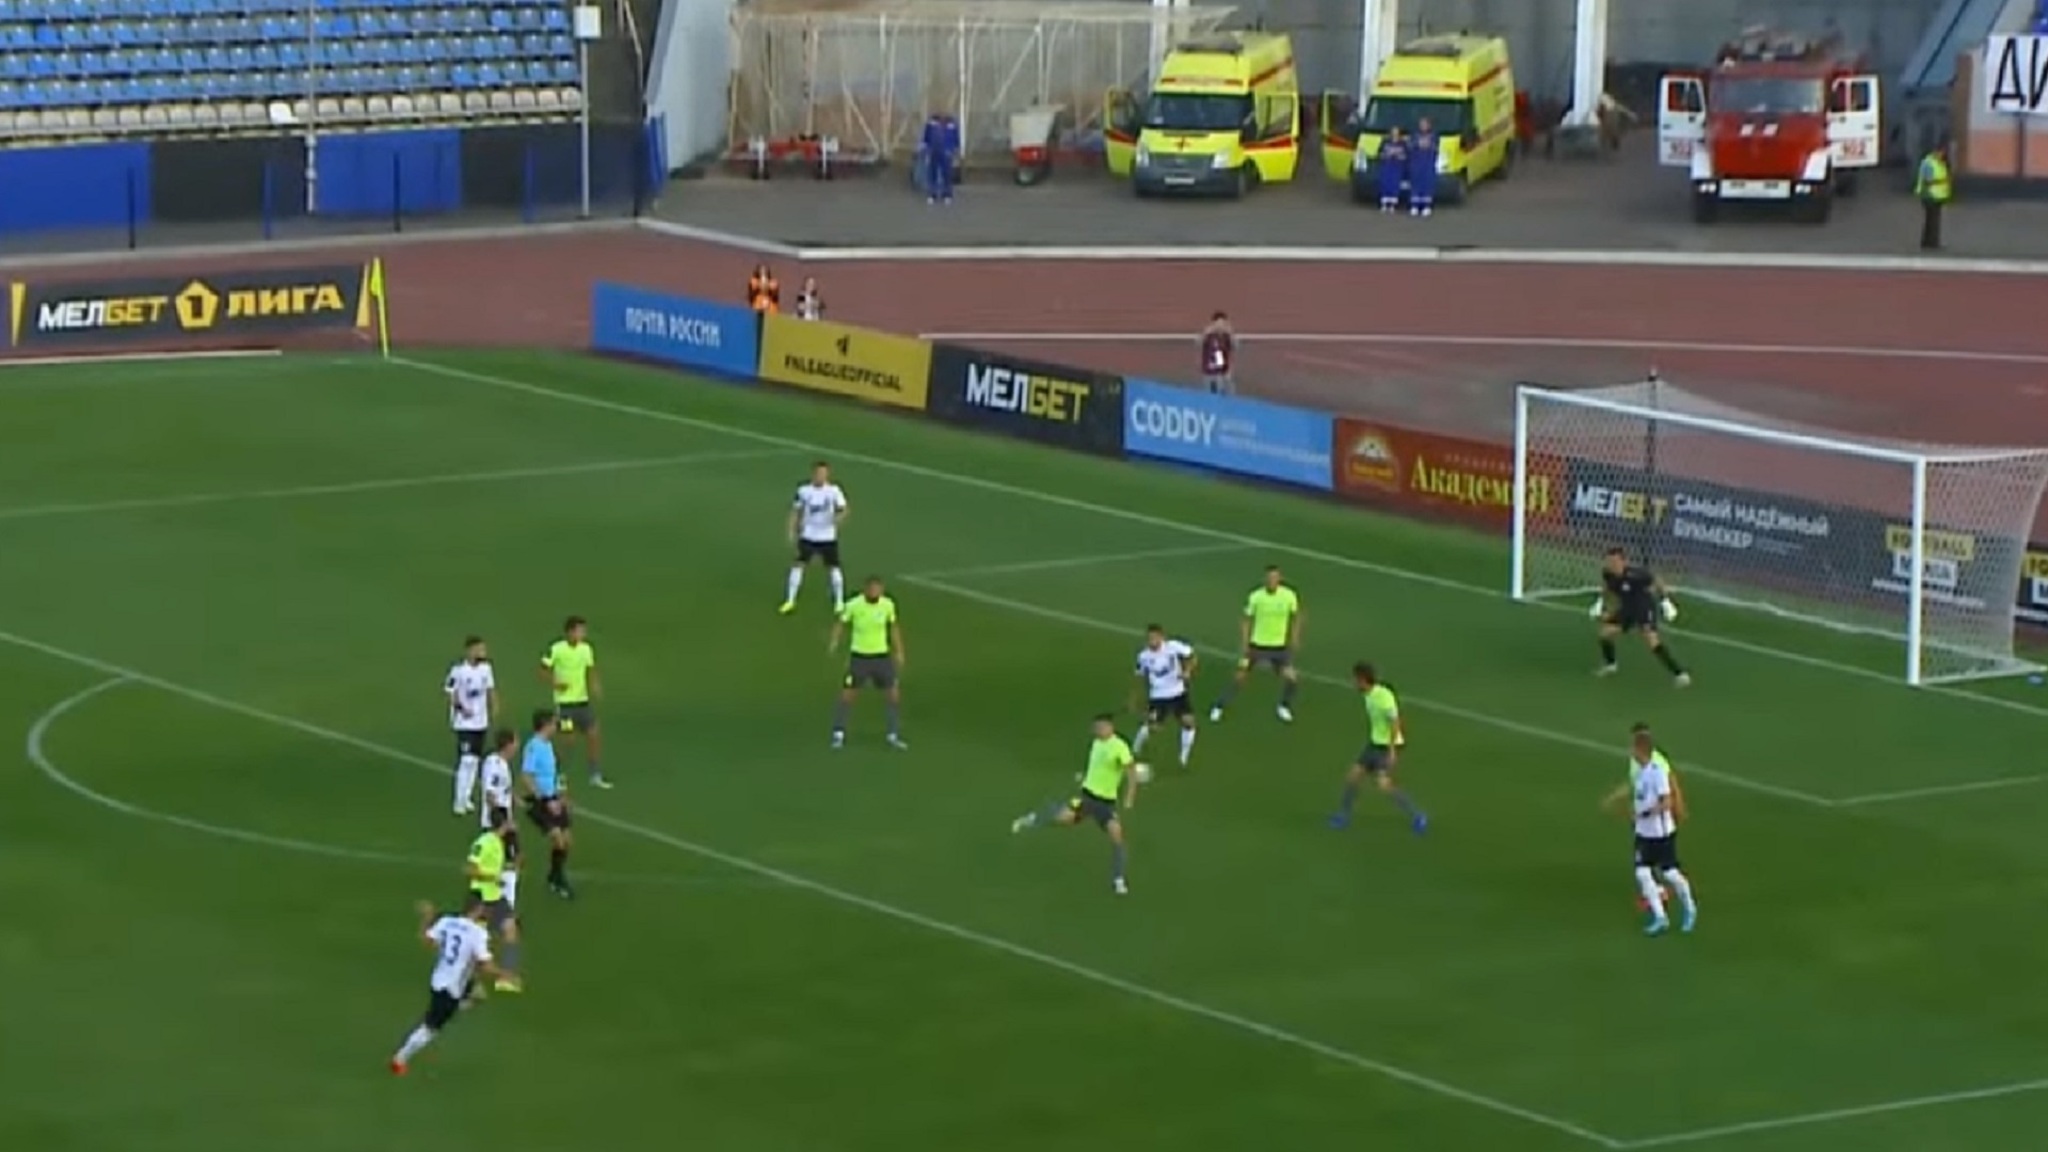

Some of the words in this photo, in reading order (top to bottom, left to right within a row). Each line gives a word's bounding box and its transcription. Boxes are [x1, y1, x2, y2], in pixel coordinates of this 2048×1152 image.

[38, 296, 168, 331] МЕЛБЕТ
[227, 284, 345, 317] ЛИГА
[625, 307, 667, 337] ПОЧТА
[668, 314, 721, 348] РОССИИ
[965, 363, 1090, 424] МЕЛБЕТ
[1130, 399, 1216, 445] CODDY
[438, 929, 462, 966] 13
